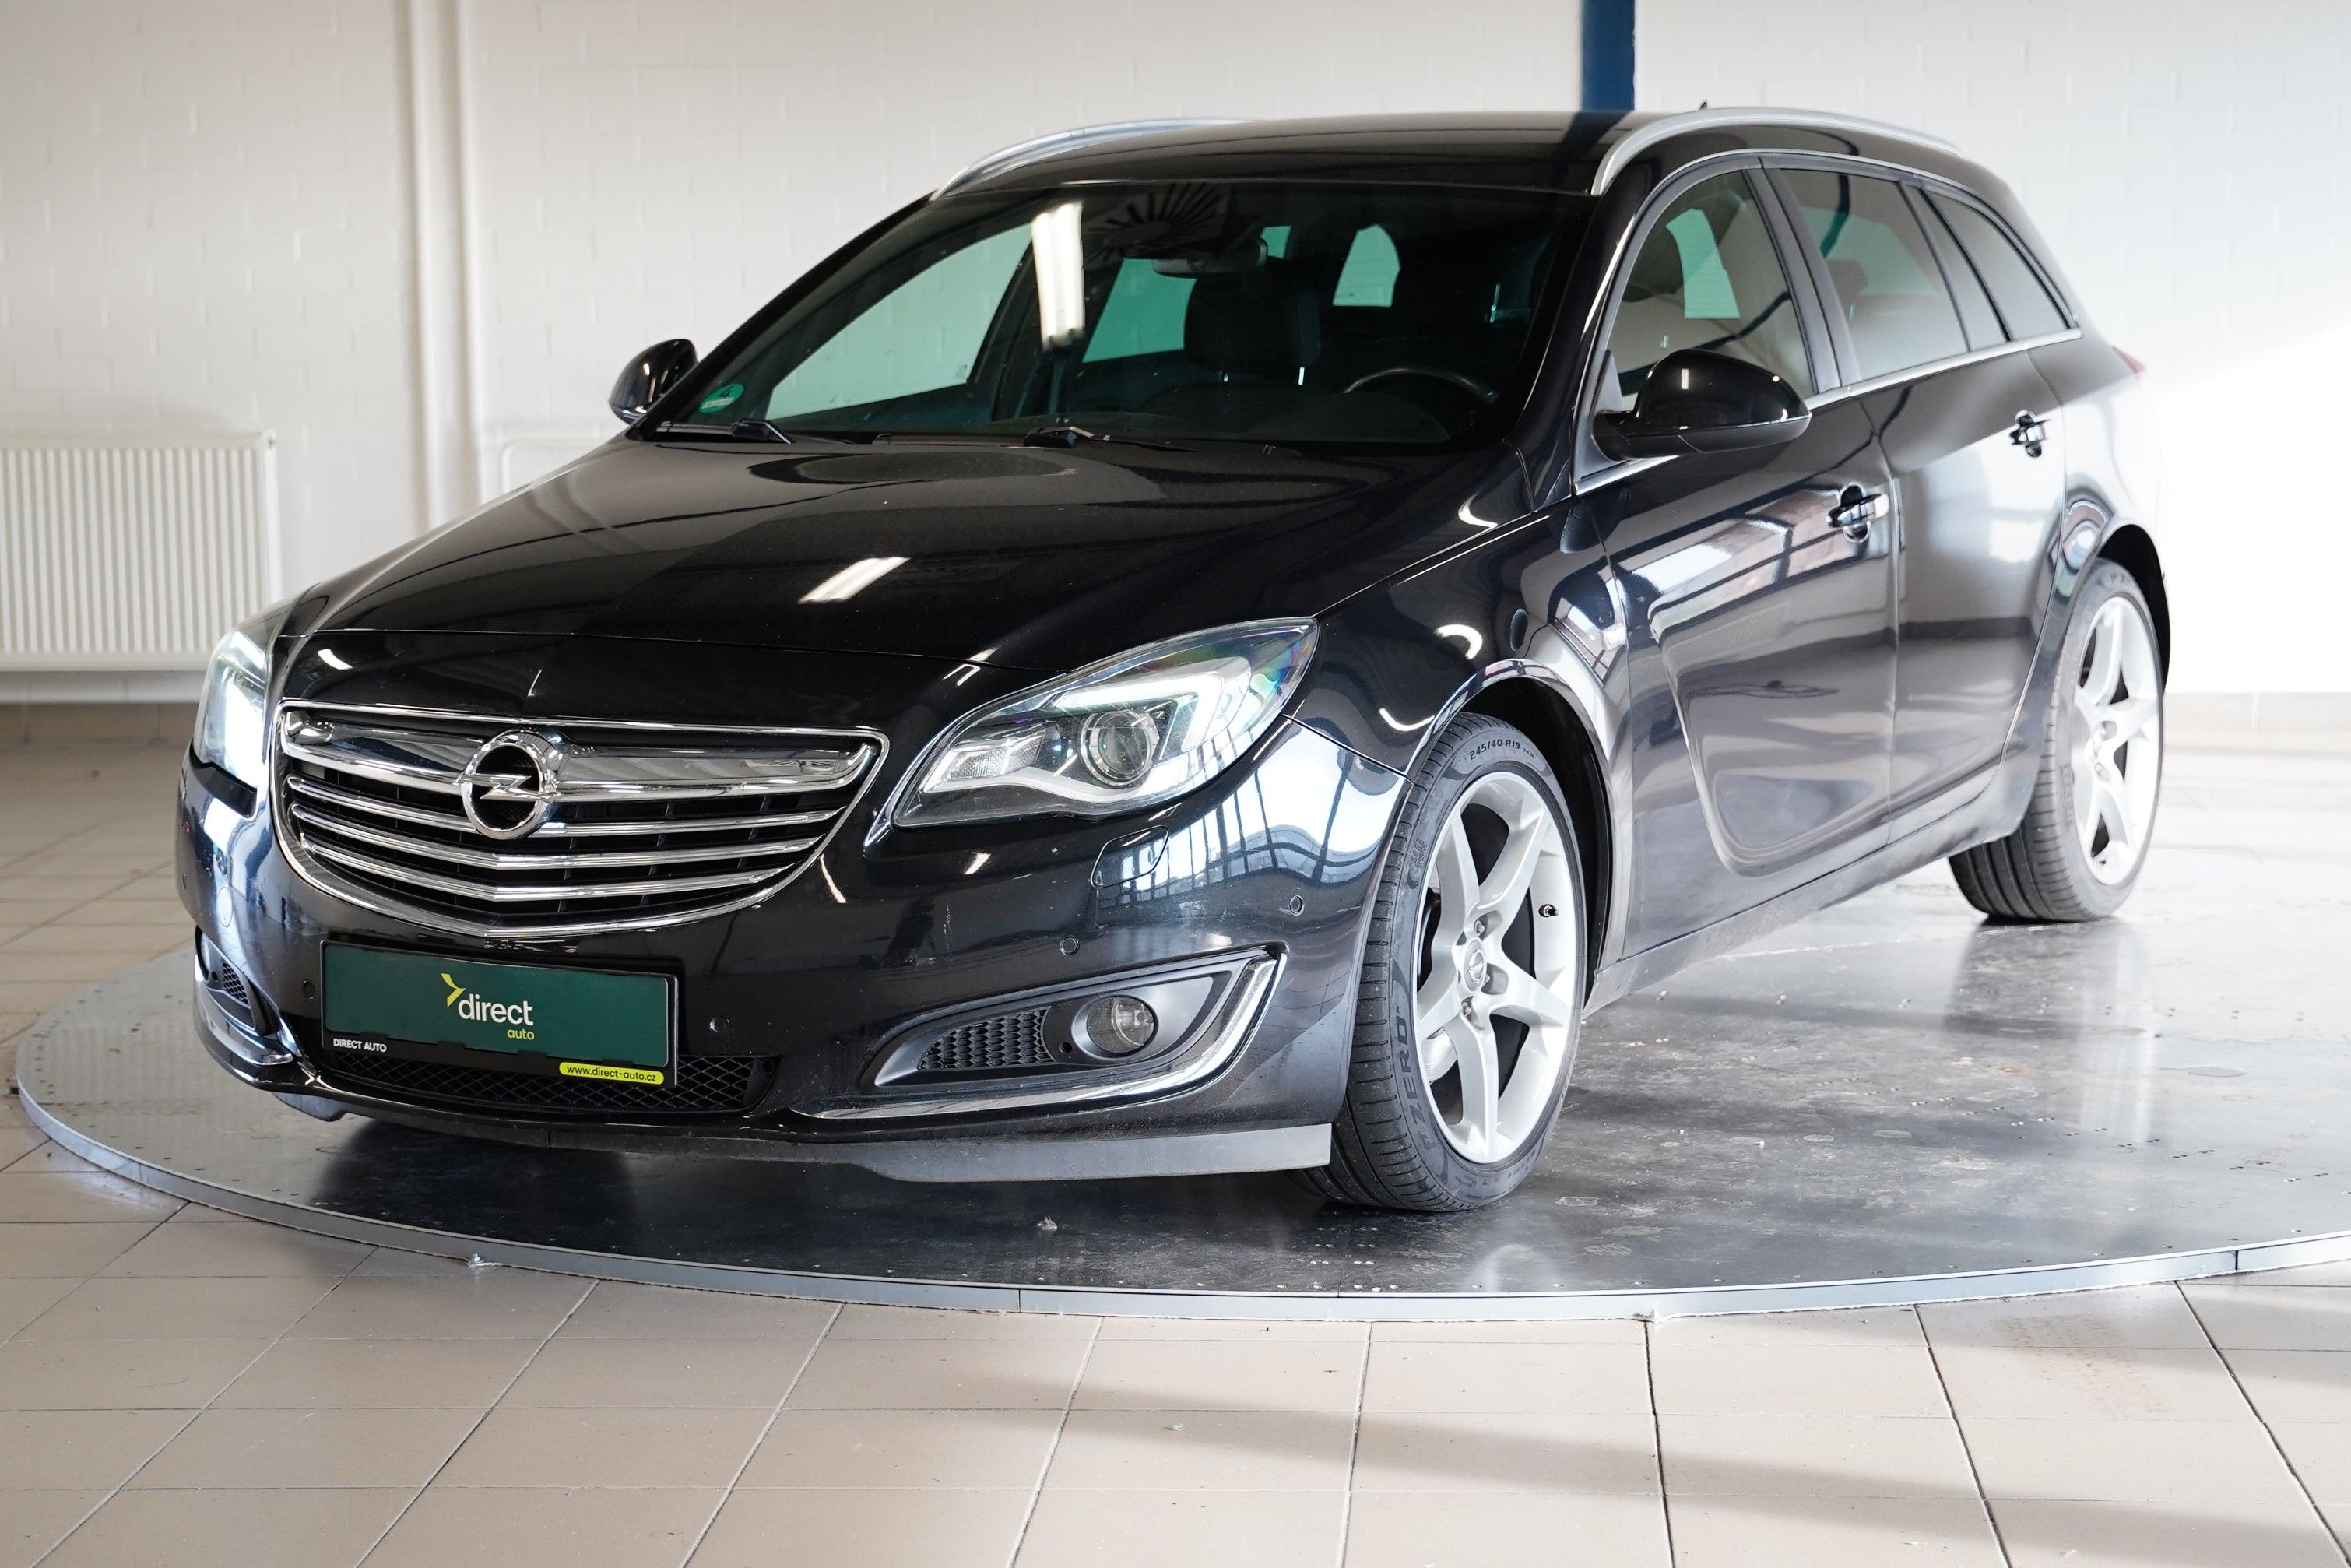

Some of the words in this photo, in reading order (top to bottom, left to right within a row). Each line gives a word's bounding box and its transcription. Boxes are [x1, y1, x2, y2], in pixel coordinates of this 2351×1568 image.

[1469, 739, 1503, 761] 245/40
[1505, 739, 1520, 749] R19
[458, 993, 534, 1026] direct
[507, 1028, 535, 1040] auto
[333, 1038, 363, 1049] DIRECT
[364, 1042, 388, 1053] AUTO
[567, 1066, 656, 1081] www.direct-auto.cz
[1396, 1016, 1425, 1125] ZERO
